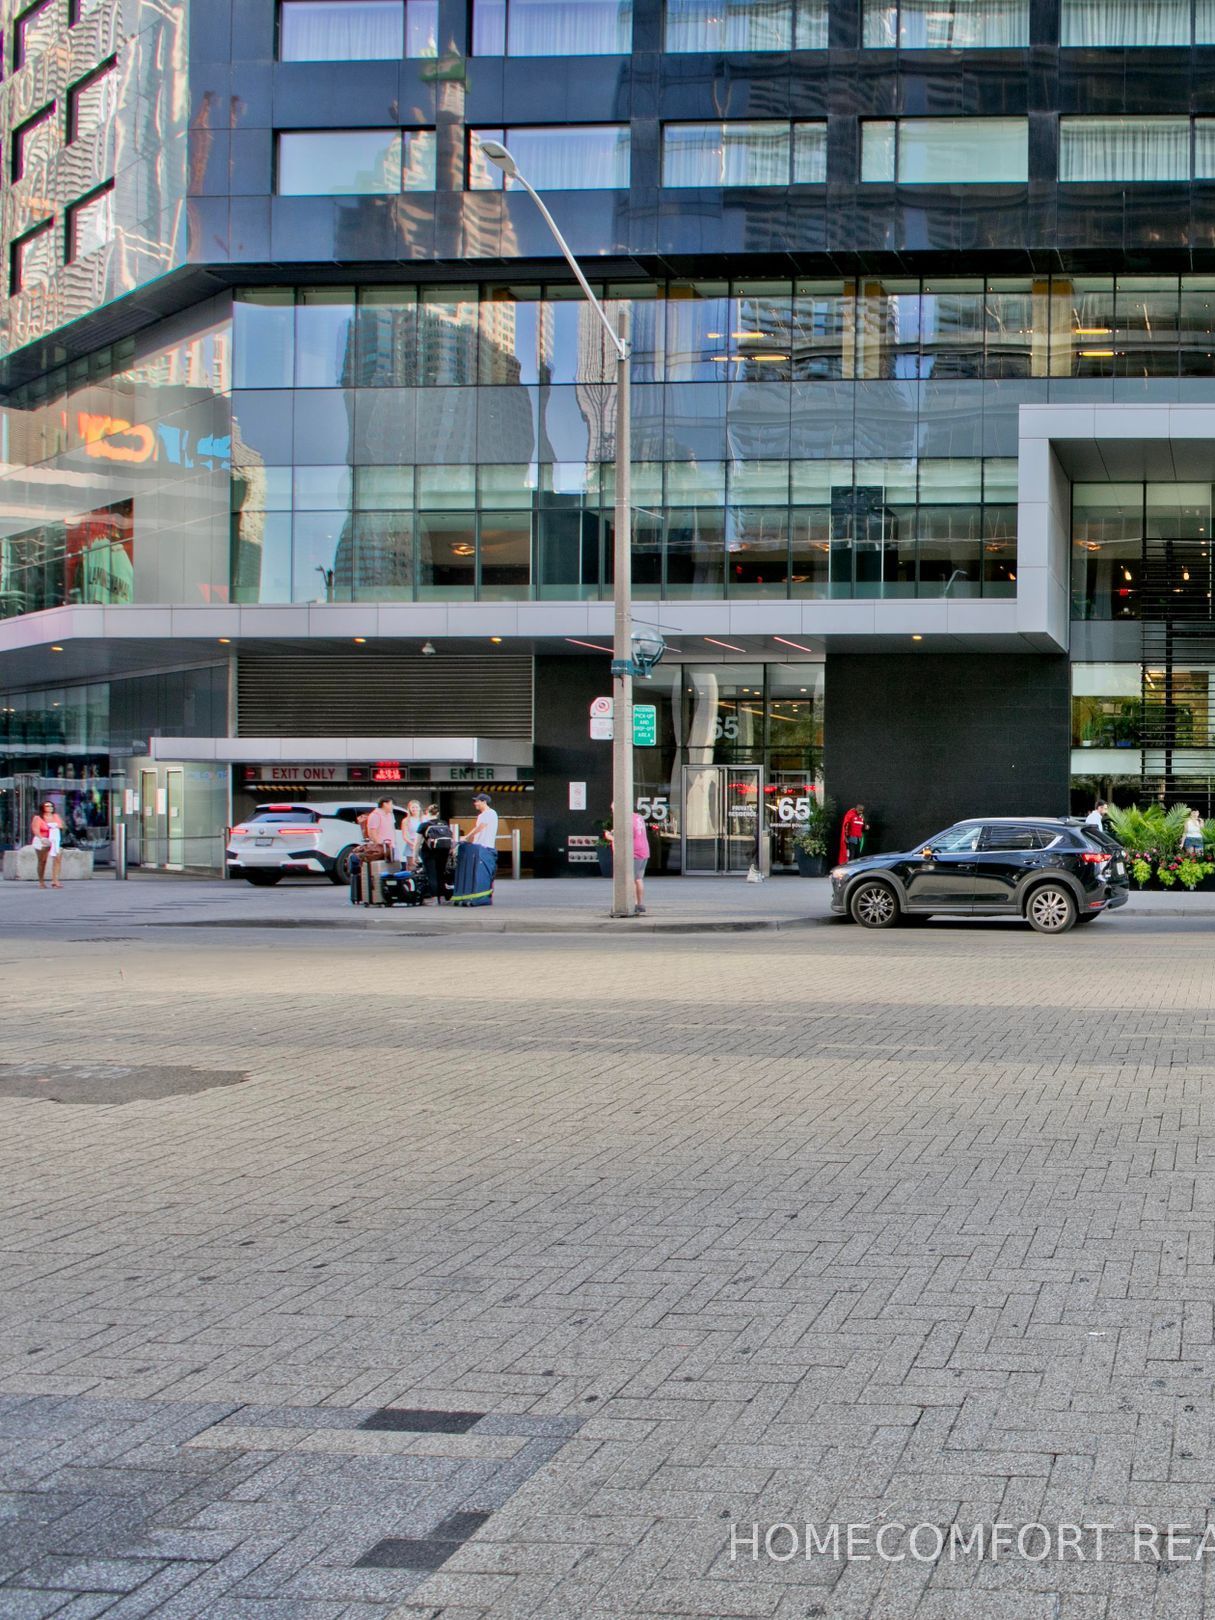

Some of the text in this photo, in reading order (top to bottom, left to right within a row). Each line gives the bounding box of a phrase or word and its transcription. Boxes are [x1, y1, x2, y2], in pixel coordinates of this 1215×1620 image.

[272, 768, 336, 779] EXIT ONLY
[450, 768, 495, 779] ENTER
[637, 797, 667, 820] 55
[779, 797, 810, 820] 65
